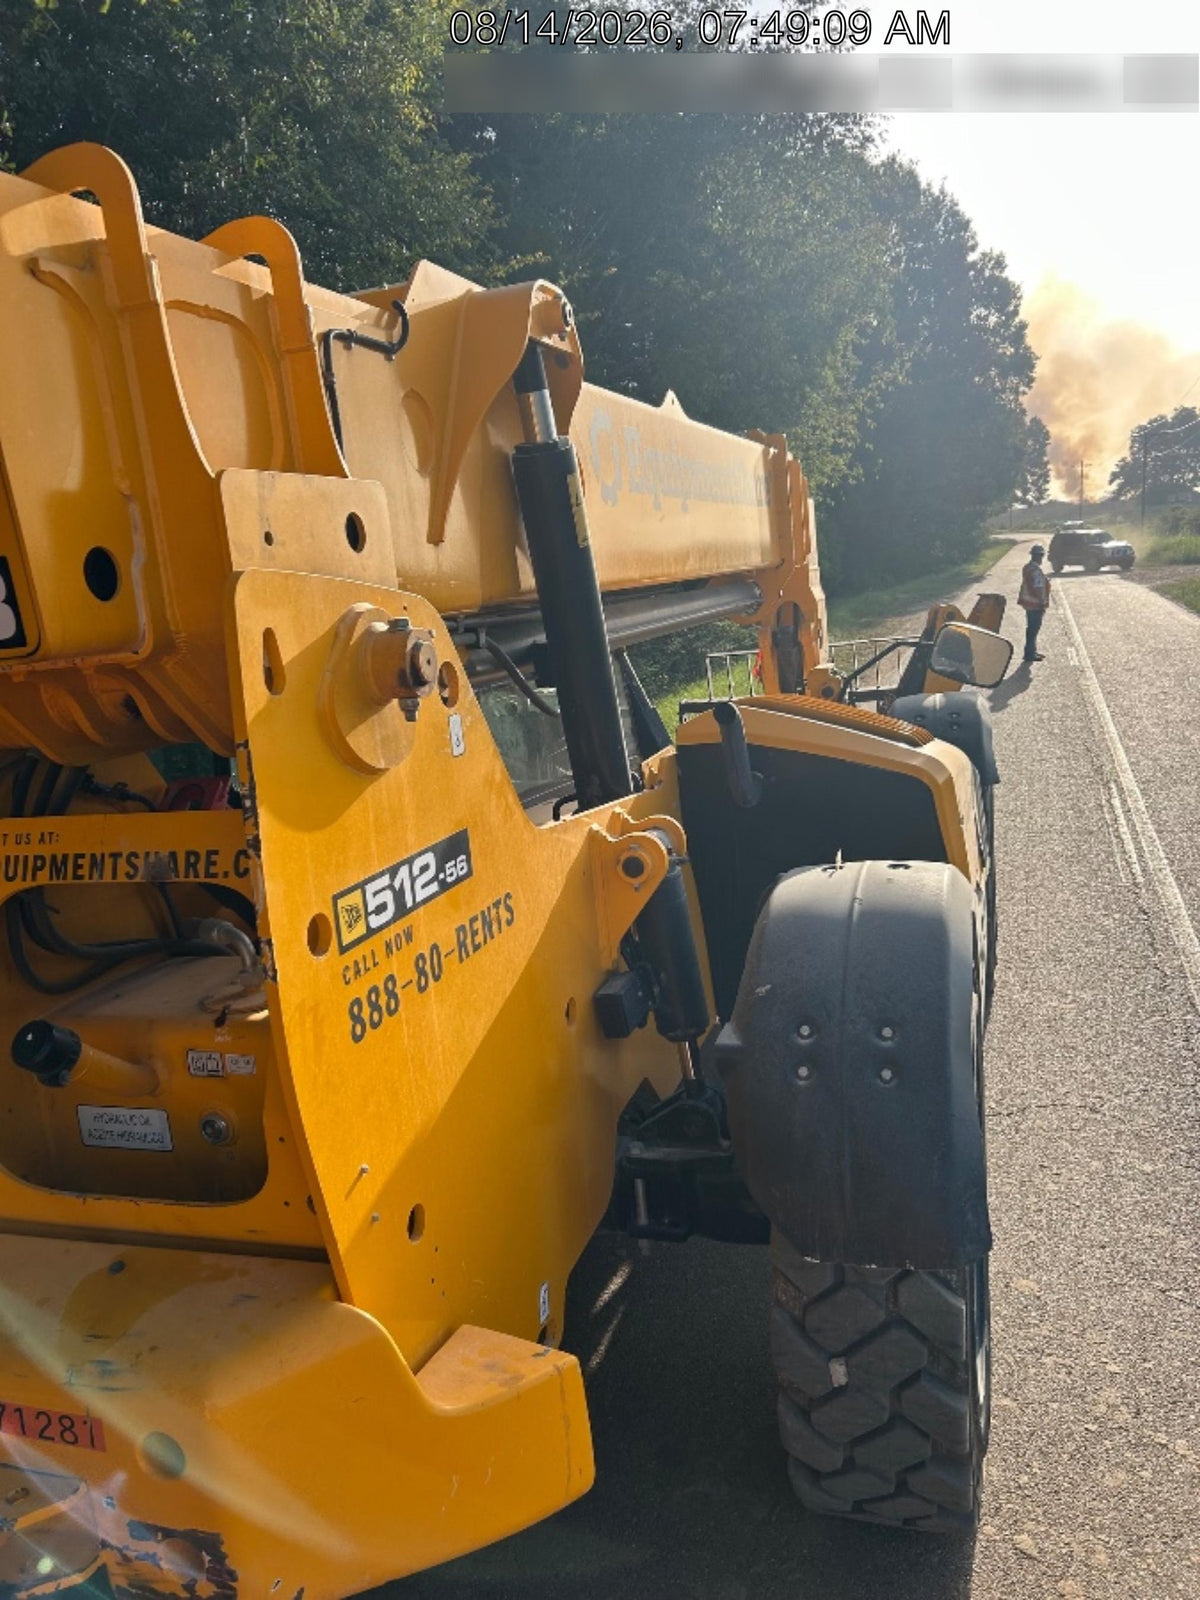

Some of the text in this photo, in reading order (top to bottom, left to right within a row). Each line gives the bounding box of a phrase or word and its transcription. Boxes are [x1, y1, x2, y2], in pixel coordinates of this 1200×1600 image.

[15, 832, 31, 845] US
[38, 831, 60, 845] AT:
[4, 849, 251, 883] UIPMENTSARE.C
[342, 924, 415, 986] CALL NOW
[349, 891, 516, 1044] 888-80-RENTS
